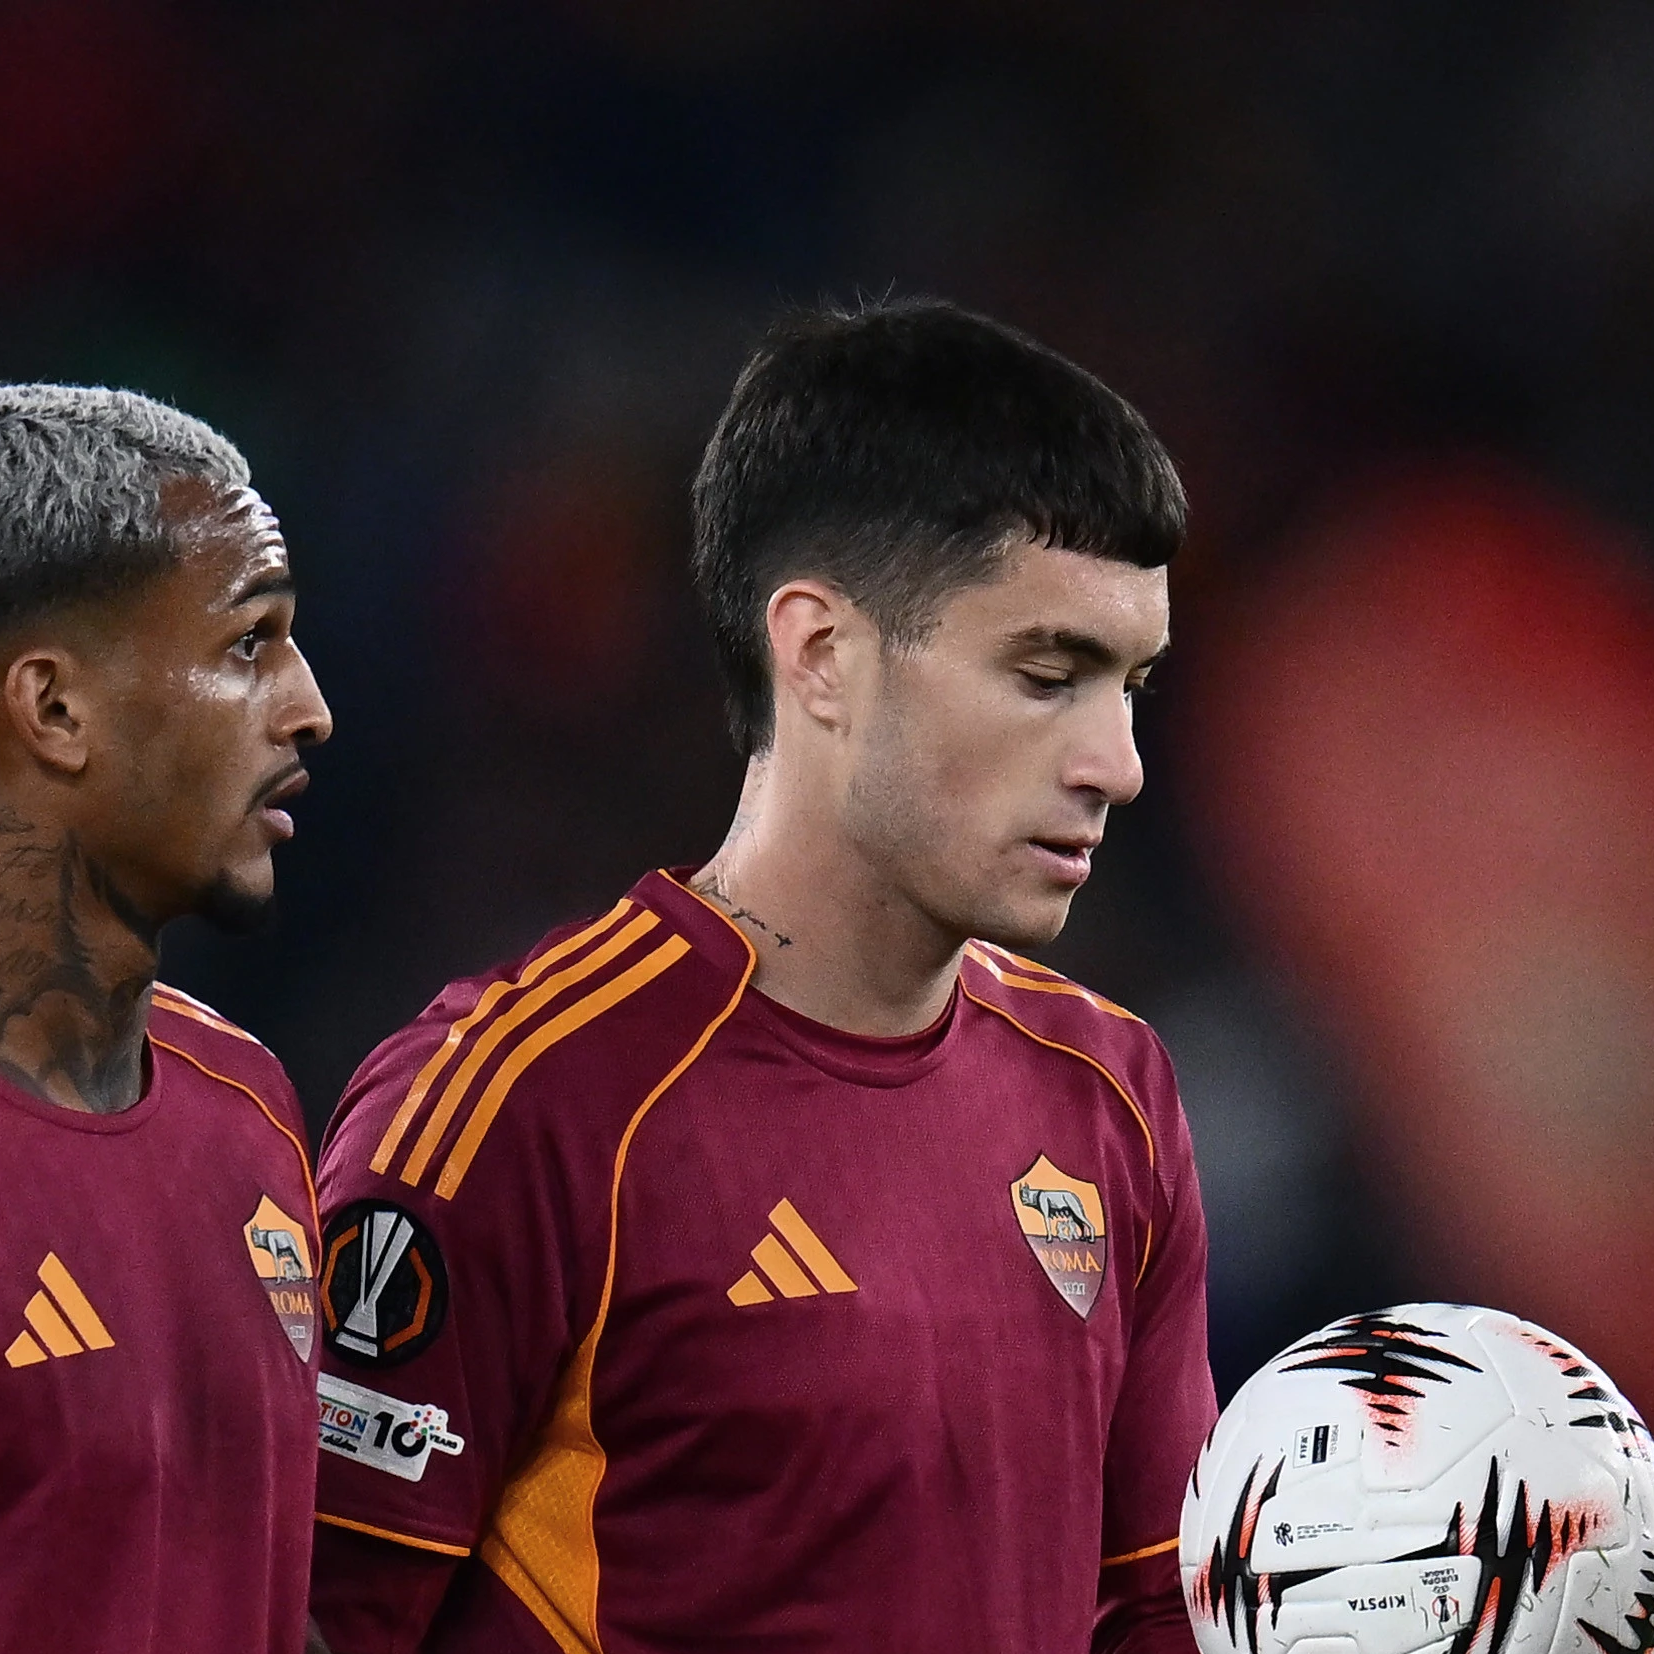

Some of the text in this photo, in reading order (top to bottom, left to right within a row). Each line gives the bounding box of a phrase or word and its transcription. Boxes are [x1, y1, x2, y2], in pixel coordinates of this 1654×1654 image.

[1041, 1249, 1101, 1272] ROMA
[269, 1291, 314, 1315] ROMA
[320, 1402, 368, 1434] TION
[373, 1411, 427, 1457] 10
[429, 1433, 458, 1449] YEARS
[1299, 1435, 1308, 1459] FIFA
[1421, 1574, 1459, 1586] EUROPA
[1347, 1595, 1406, 1611] KIPSTA
